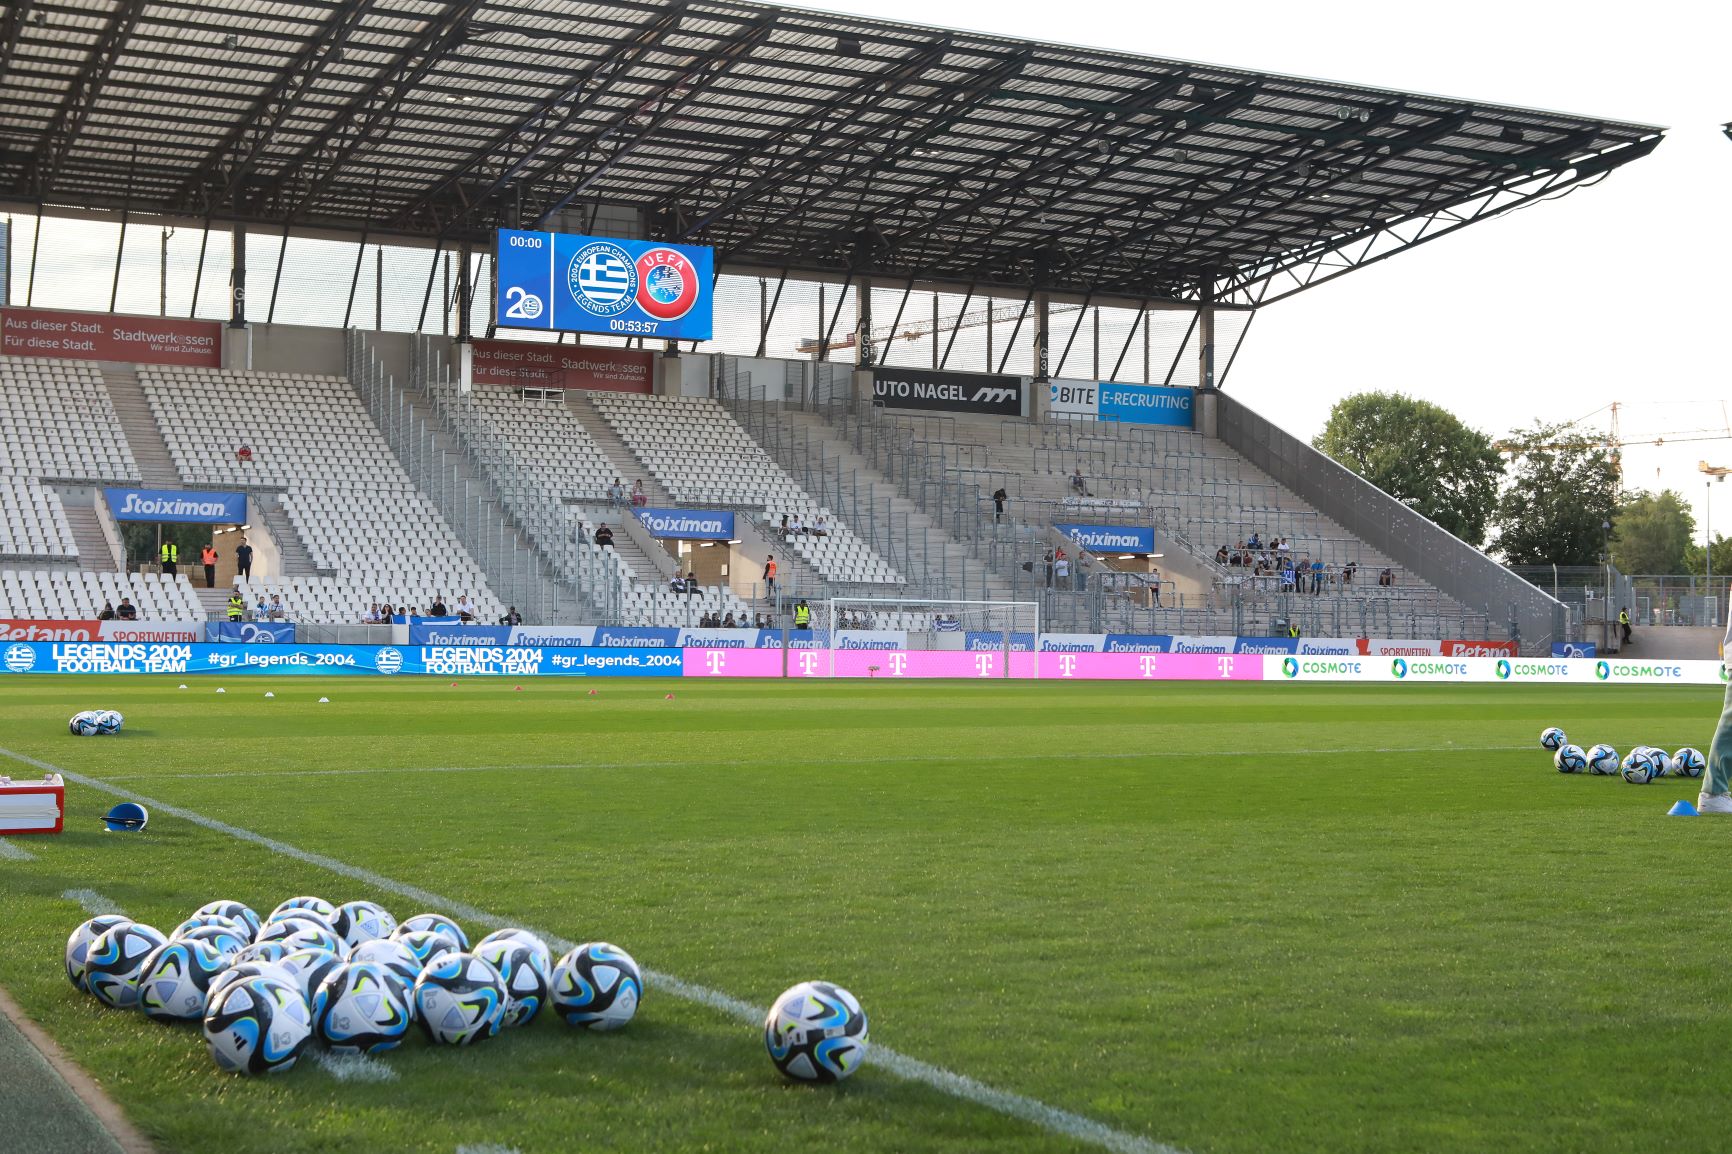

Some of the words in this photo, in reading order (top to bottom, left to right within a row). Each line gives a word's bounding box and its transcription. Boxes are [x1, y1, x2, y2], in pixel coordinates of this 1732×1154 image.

[510, 236, 542, 248] 00:00
[571, 263, 580, 283] 2004
[576, 245, 611, 264] EUROPEAN
[611, 248, 637, 288] CHAMPIONS
[644, 252, 684, 270] UEFA
[573, 289, 610, 314] LEGENDS
[611, 294, 633, 312] TEAM
[4, 317, 28, 330] Aus
[31, 318, 68, 332] dieser
[70, 321, 104, 334] Stadt.
[610, 319, 659, 334] 00:53:57
[4, 335, 25, 347] Für
[27, 336, 60, 349] diese
[62, 338, 97, 351] Stadt.
[150, 343, 163, 351] Wir
[164, 344, 180, 352] sind
[181, 345, 213, 354] Zuhause.
[472, 349, 491, 360] Aus
[493, 350, 524, 362] dieser
[526, 351, 556, 363] Stadt.
[489, 366, 517, 377] diese
[605, 372, 618, 380] sind
[873, 380, 910, 397] UTO
[914, 382, 968, 401] NAGEL
[1060, 386, 1096, 405] BITE
[1102, 391, 1190, 410] E-RECRUITING
[120, 493, 225, 516] Stoiximan
[113, 631, 197, 642] SPORTWETTEN
[425, 631, 496, 645] Stoiximan
[514, 632, 582, 646] Stoiximan
[599, 633, 665, 647] Stoiximan
[682, 634, 746, 648] Stoiximan
[761, 634, 824, 649] Stoximan
[839, 636, 899, 650] Stoiximan
[52, 643, 146, 660] LEGENDS
[149, 644, 192, 661] 2004
[1040, 640, 1095, 652] Stoiximan
[1108, 640, 1161, 653] Stoiximan
[1175, 641, 1226, 654] Stoiximan
[1239, 643, 1289, 655] Stoiximan
[1300, 643, 1349, 655] Stoiximan
[208, 652, 356, 668] #gr_legends_2004
[421, 647, 504, 663] LEGENDS
[505, 648, 544, 663] 2004
[551, 653, 682, 668] #gr_legends_2004
[706, 650, 726, 674] T
[57, 659, 140, 673] FOOTBALL
[142, 660, 186, 673] TEAM
[425, 662, 499, 674] FOOTBALL
[500, 662, 539, 674] TEAM
[799, 651, 818, 675] T
[889, 652, 907, 675] T
[975, 653, 992, 676] T
[1059, 654, 1076, 677] T
[1139, 655, 1156, 677] T
[1217, 656, 1234, 678] T
[1302, 662, 1362, 674] COSMOTE
[1410, 663, 1467, 675] COSMOTE
[1514, 664, 1569, 676] COSMOTE
[1613, 665, 1682, 677] COSMOTE
